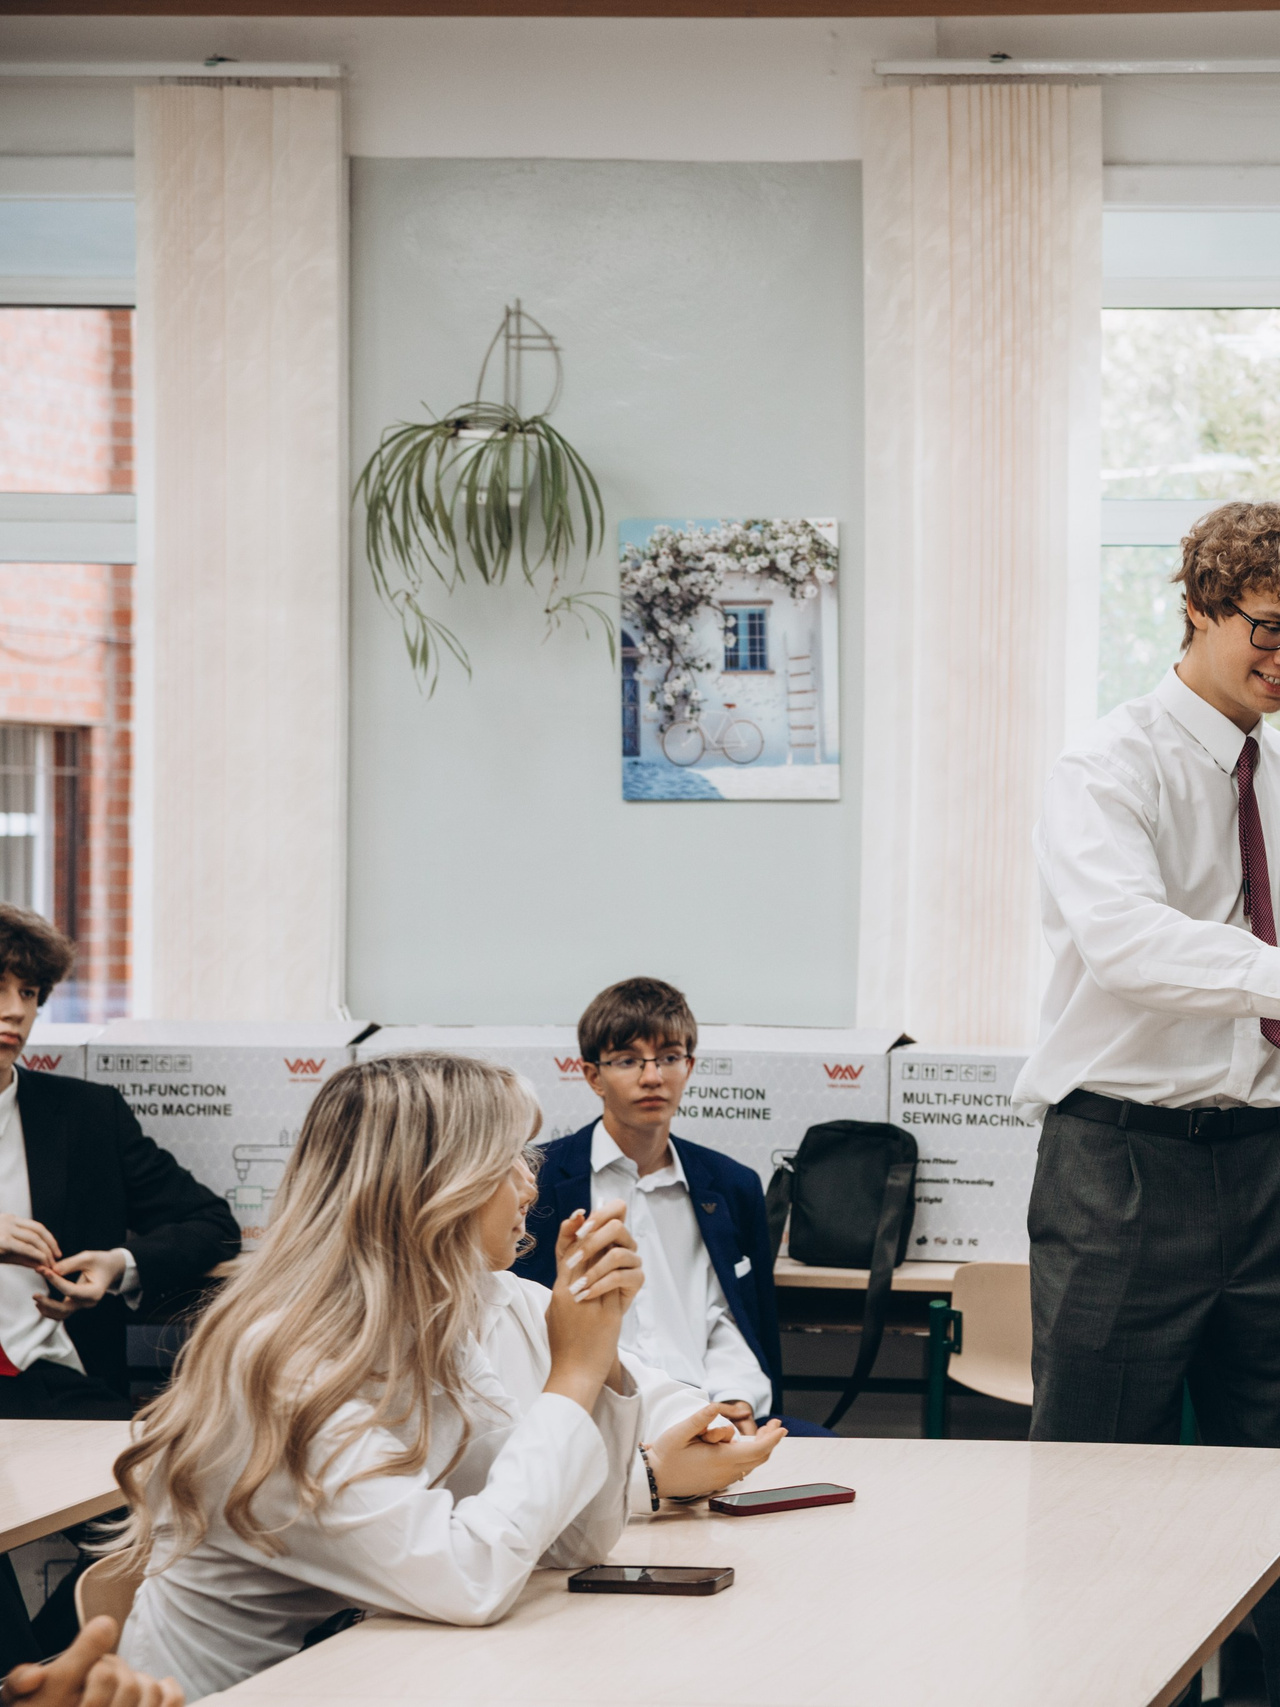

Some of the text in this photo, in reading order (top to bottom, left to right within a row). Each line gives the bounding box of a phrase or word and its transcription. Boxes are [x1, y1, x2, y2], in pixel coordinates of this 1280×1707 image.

[117, 1083, 227, 1097] LTI-FUNCTION
[902, 1092, 1012, 1107] MULTI-FUNCTI
[162, 1103, 233, 1117] MACHINE
[702, 1106, 772, 1121] MACHINE
[902, 1111, 963, 1126] SEWING
[952, 1177, 995, 1188] Threading
